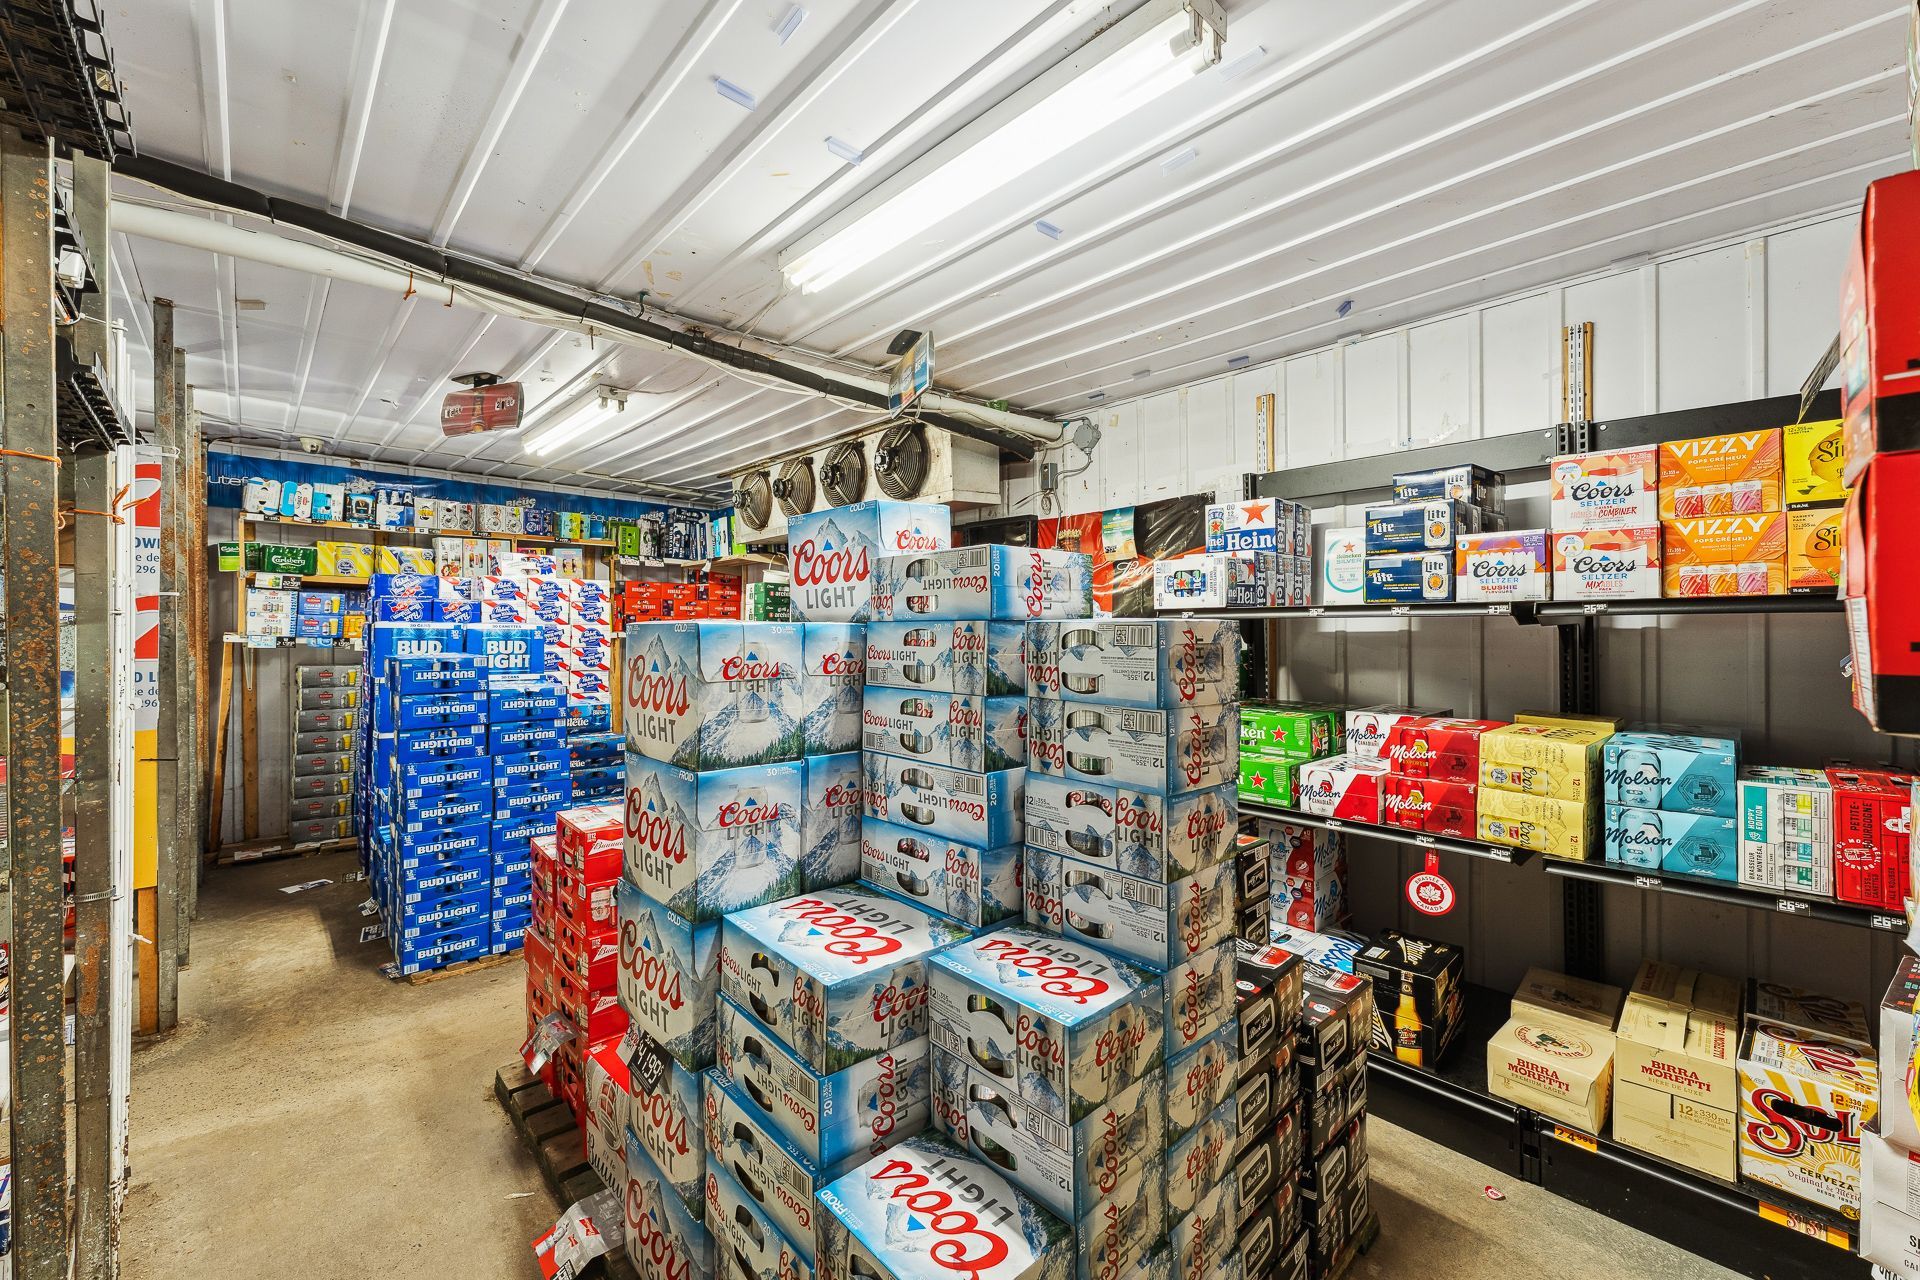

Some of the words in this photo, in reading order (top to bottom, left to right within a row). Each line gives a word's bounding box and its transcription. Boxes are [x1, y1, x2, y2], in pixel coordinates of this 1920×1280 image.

[1669, 434, 1761, 458] VIZZY
[1710, 454, 1747, 462] CRÉMEUX
[1570, 482, 1634, 501] Coors
[850, 503, 866, 513] COLD
[1580, 498, 1626, 507] SELTZER
[1598, 506, 1638, 518] COMBINER
[1372, 522, 1395, 536] Lite
[1675, 516, 1768, 536] VIZZY
[896, 530, 938, 551] Coors
[136, 565, 156, 574] 296
[272, 556, 306, 566] Carlsberg
[792, 538, 870, 586] Coors
[1472, 560, 1527, 578] Coors
[1573, 556, 1636, 574] Coors
[922, 577, 951, 590] LIGHT
[951, 574, 988, 592] Coors
[1026, 551, 1043, 618] Coors
[1585, 580, 1623, 590] MIXABLES
[804, 586, 856, 609] LIGHT
[674, 623, 688, 632] COLD
[488, 655, 530, 668] IGHT
[722, 655, 781, 681] Coors
[1180, 628, 1196, 702] Coors
[416, 672, 450, 680] LIGHT
[452, 670, 475, 679] BUD
[830, 676, 862, 688] LIGH
[628, 654, 690, 717] Coors
[416, 704, 450, 715] LIGHT
[452, 703, 476, 712] BUD
[503, 700, 533, 708] LIGHT
[636, 713, 676, 744] LIGHT
[864, 709, 888, 727] Coors
[888, 716, 914, 732] LIGHT
[1346, 728, 1386, 742] Molson
[507, 765, 529, 774] BUD
[530, 761, 558, 770] LIGHT
[678, 770, 694, 782] FROID
[1604, 768, 1672, 786] Molson
[420, 775, 446, 785] BUD
[447, 771, 480, 782] LIGHT
[421, 808, 446, 818] BUD
[447, 804, 480, 815] LIGHT
[718, 802, 779, 828] Coors
[832, 805, 862, 819] LIGH
[918, 792, 949, 809] LIGHT
[949, 798, 984, 822] Coors
[1850, 802, 1860, 831] PETITE-
[626, 786, 688, 864] Coors
[1187, 810, 1226, 840] Coors
[417, 845, 442, 854] BUD
[444, 838, 476, 849] LIGHT
[1192, 830, 1221, 854] LIGHT
[634, 848, 674, 888] LIGHT
[1440, 883, 1447, 891] AU
[418, 914, 443, 924] BUD
[445, 906, 477, 918] LIGHT
[1416, 900, 1444, 912] CANADA
[667, 910, 681, 926] COLD
[832, 899, 915, 936] LIGHT
[780, 898, 903, 965] Coors
[417, 949, 442, 959] BUD
[444, 939, 476, 952] LIGHT
[1021, 939, 1108, 976] LIGHT
[619, 918, 685, 1012] Coors
[950, 961, 972, 974] COLD
[976, 939, 1110, 1005] Coors
[626, 979, 670, 1034] LIGHT
[880, 1012, 928, 1040] LIGH
[1095, 1018, 1146, 1067] Coors
[708, 1068, 732, 1088] FROID
[1187, 1051, 1225, 1098] Coors
[1508, 1062, 1570, 1092] MORETTI
[1516, 1058, 1560, 1080] BIRRA
[1641, 1065, 1711, 1092] MORETTI
[1651, 1060, 1700, 1080] BIRRA
[1191, 1076, 1222, 1110] LIGHT
[1511, 1073, 1541, 1088] PREMIUM
[1544, 1085, 1566, 1096] LAGER
[1684, 1088, 1704, 1096] LUXE
[756, 1070, 784, 1097] LIGHT
[783, 1094, 816, 1135] Coors
[1830, 1092, 1844, 1106] 12
[1679, 1103, 1693, 1117] 12
[1699, 1110, 1718, 1120] 330
[636, 1120, 676, 1175] LIGHT
[1787, 1169, 1823, 1188] Original
[1800, 1167, 1855, 1192] CERVEZA
[922, 1158, 1015, 1227] LIGHT
[1816, 1189, 1835, 1199] DESDE
[820, 1190, 851, 1219] FROID
[870, 1158, 1009, 1280] Coors
